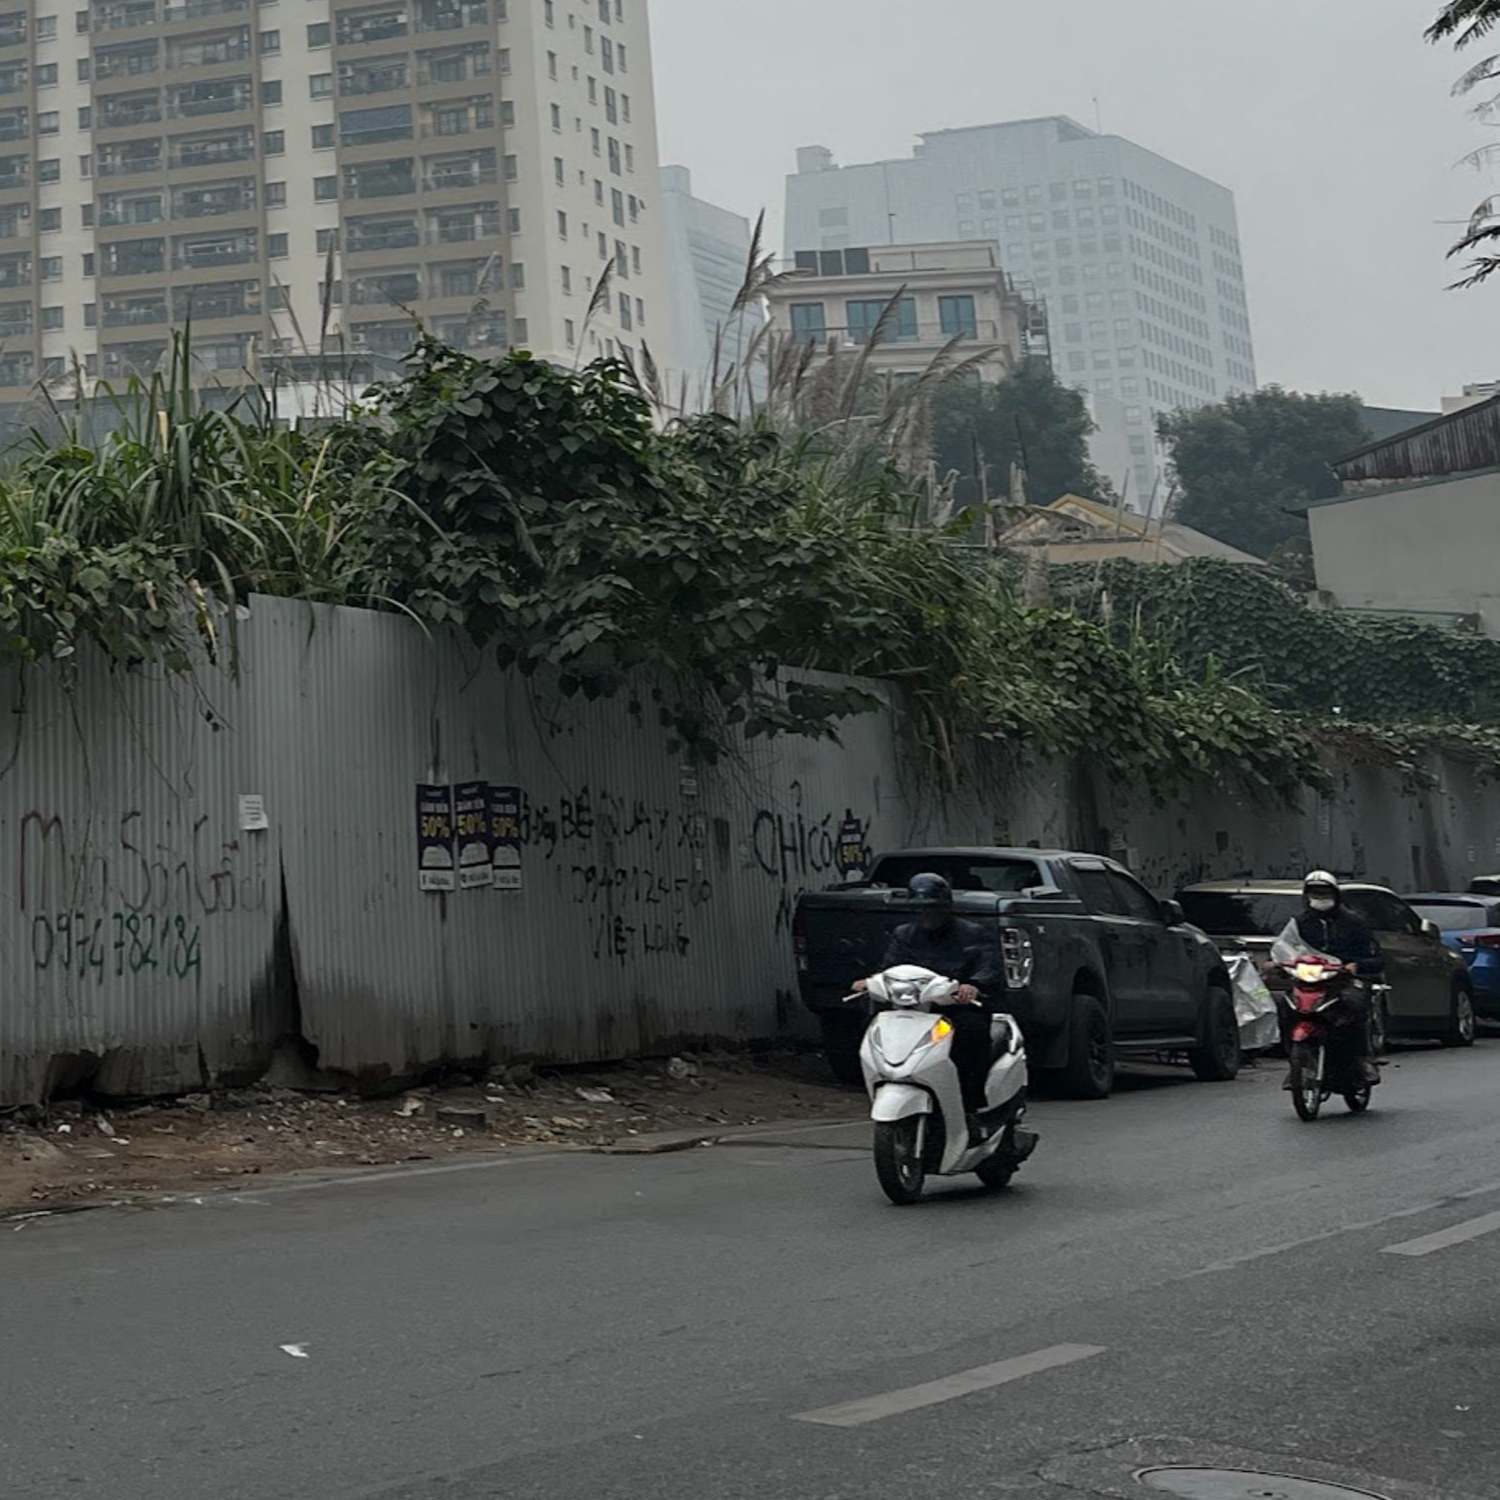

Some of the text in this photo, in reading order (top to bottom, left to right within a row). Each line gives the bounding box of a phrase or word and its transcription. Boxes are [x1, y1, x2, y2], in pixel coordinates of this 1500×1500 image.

[421, 814, 451, 838] 50%
[456, 812, 487, 836] 50%
[492, 816, 520, 838] 50%
